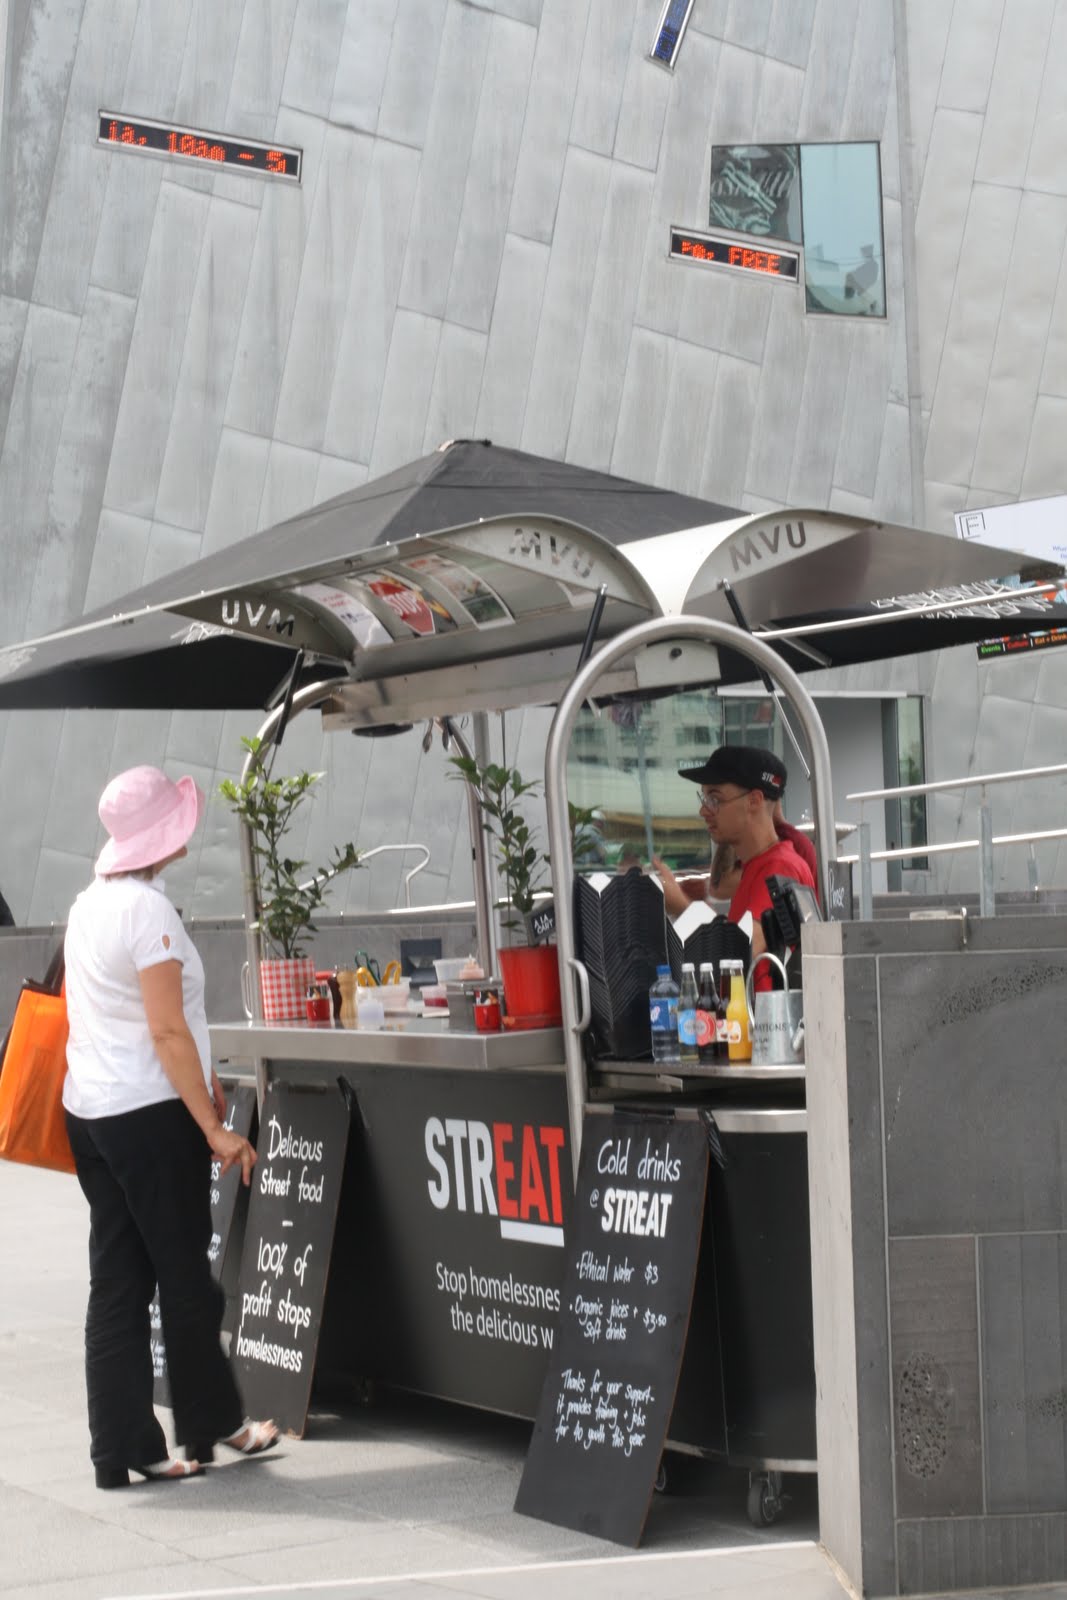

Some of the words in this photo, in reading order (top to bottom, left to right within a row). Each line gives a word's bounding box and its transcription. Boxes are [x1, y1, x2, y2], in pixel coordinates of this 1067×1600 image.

[167, 132, 225, 162] 10am
[266, 150, 286, 174] 5
[728, 246, 781, 275] FREE
[508, 527, 595, 578] MVU
[728, 521, 808, 572] MVU
[267, 1114, 323, 1162] Delicious
[597, 1137, 631, 1176] Cold
[637, 1137, 682, 1182] drinks
[260, 1167, 291, 1197] Street
[298, 1165, 324, 1203] food
[424, 1116, 565, 1225] STREAT
[601, 1187, 673, 1238] STREAT
[257, 1236, 288, 1280] 100%
[294, 1243, 313, 1287] of
[436, 1262, 467, 1301] Stop
[644, 1261, 659, 1286] $3
[241, 1280, 272, 1328] profit
[277, 1288, 312, 1339] stops
[450, 1301, 473, 1334] the
[476, 1306, 538, 1347] delicious
[605, 1322, 627, 1340] drinks
[236, 1325, 303, 1373] homelessness
[590, 1368, 603, 1400] for
[555, 1414, 570, 1443] for
